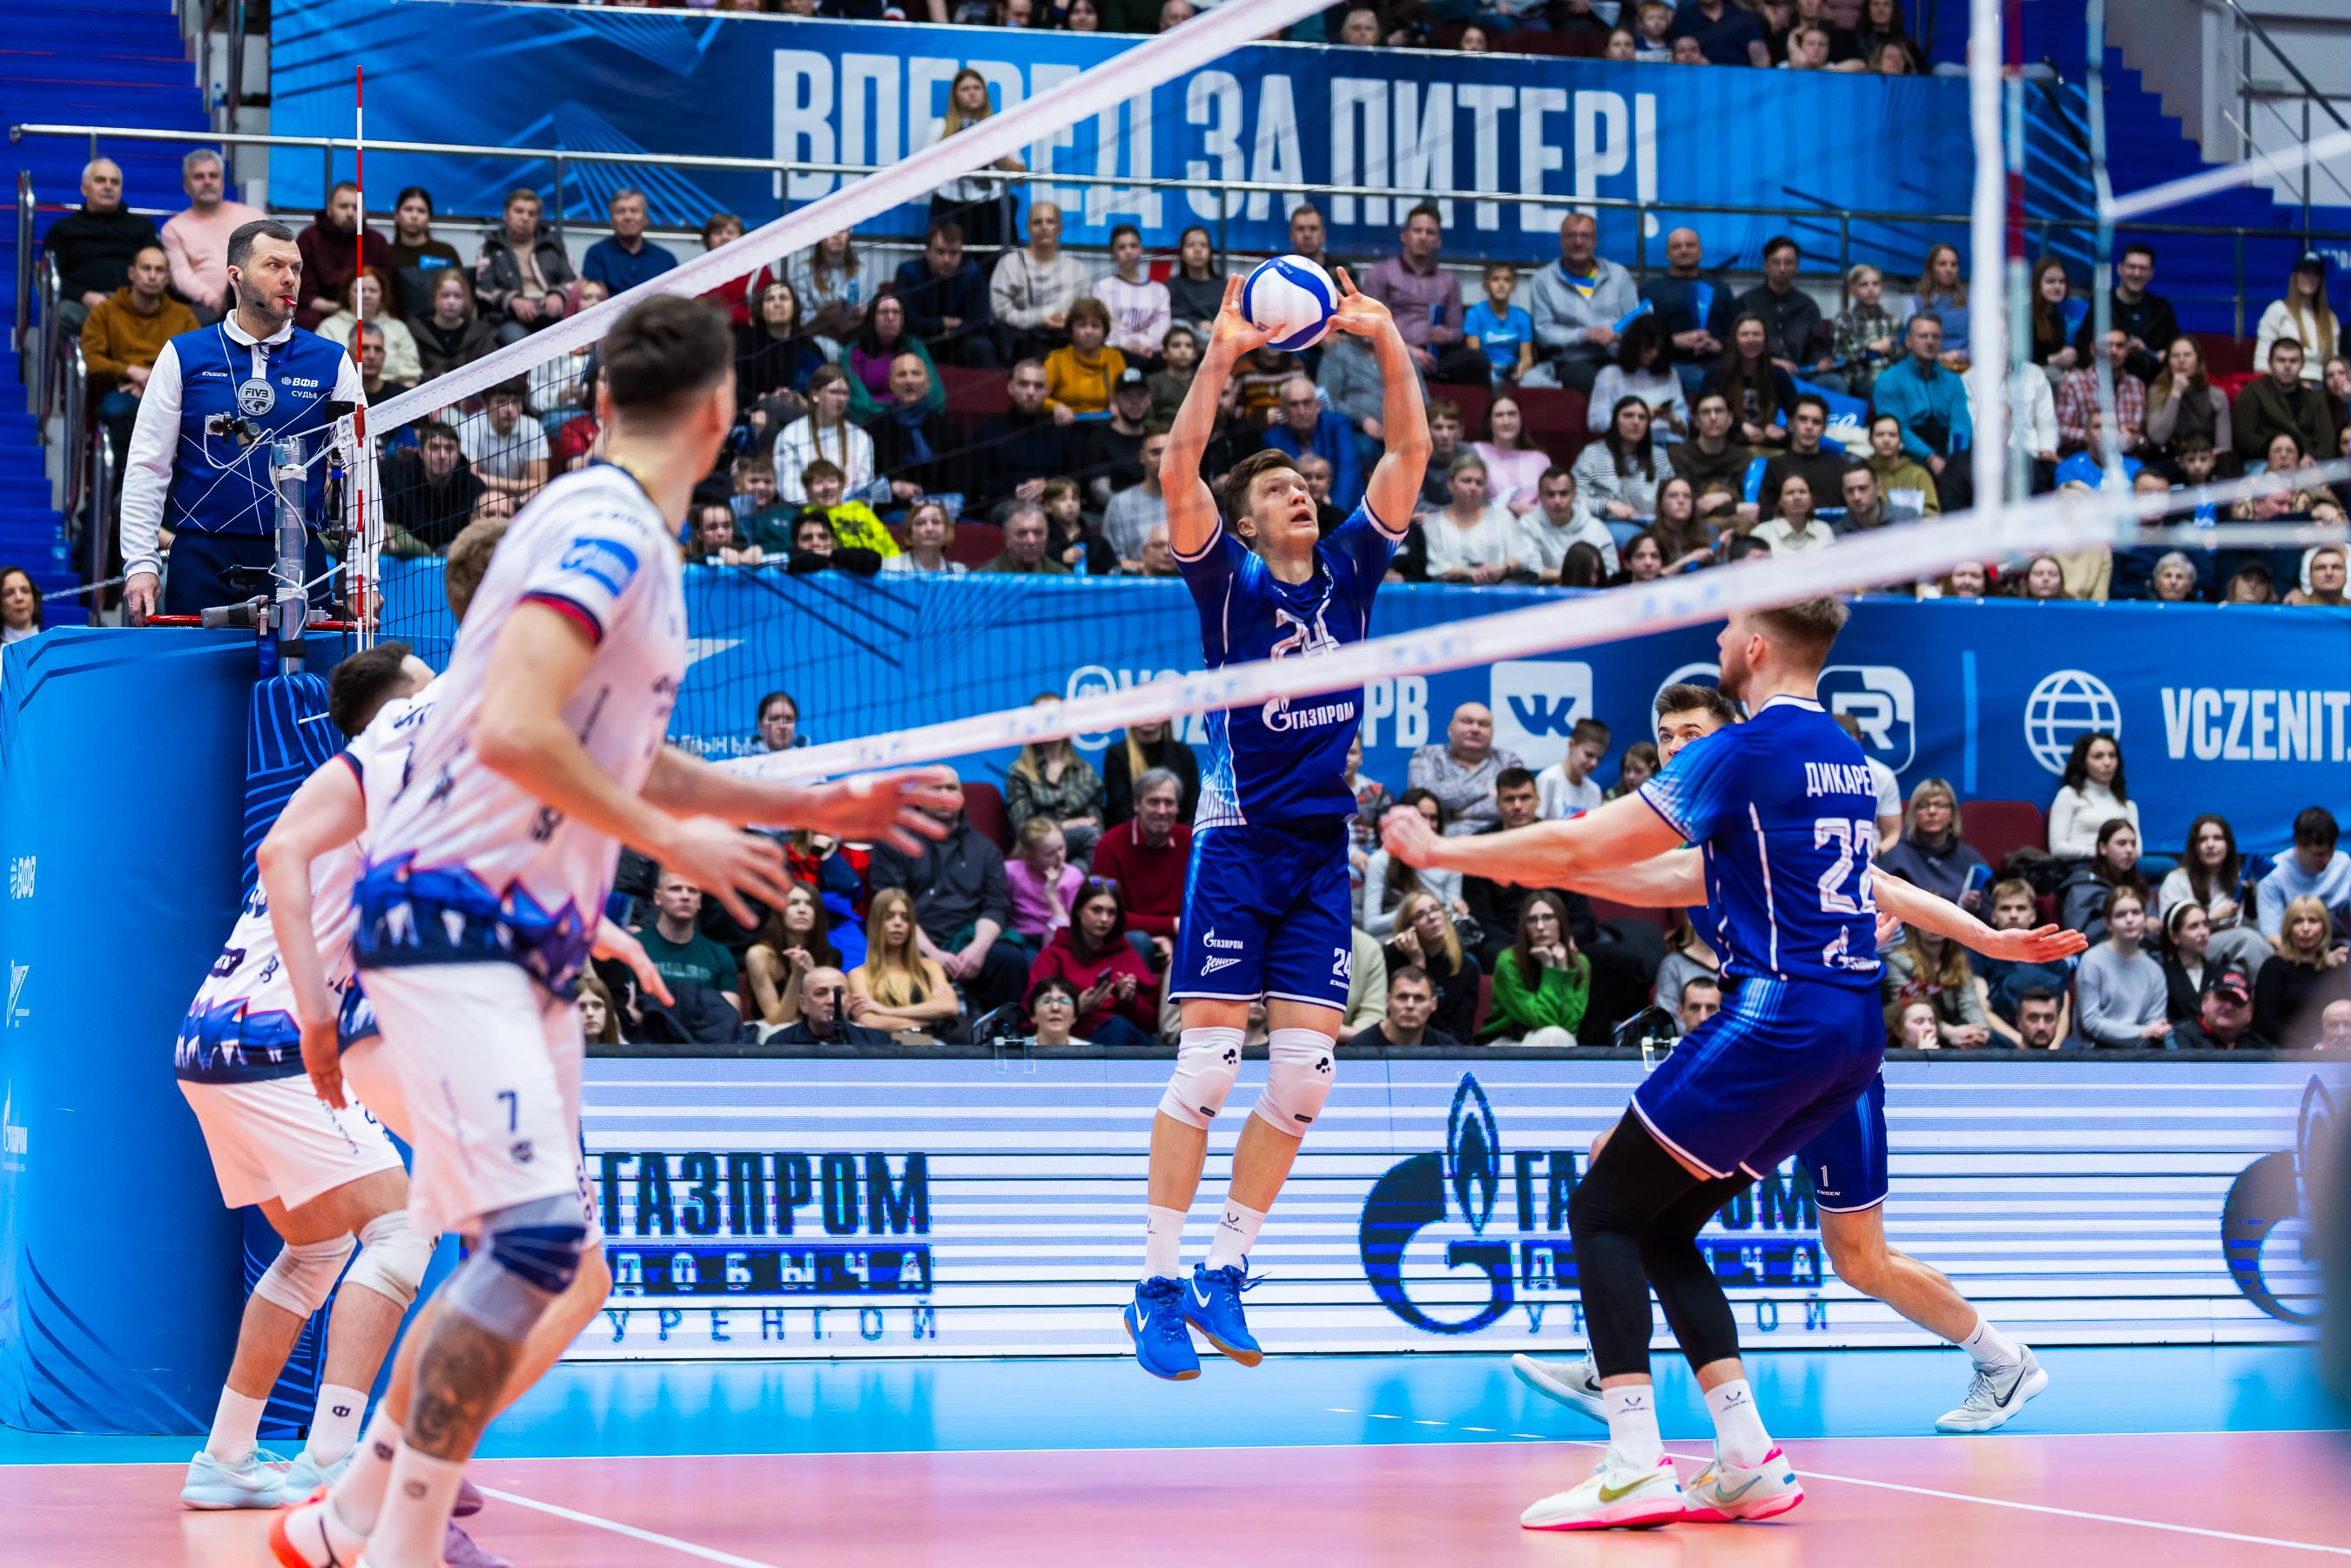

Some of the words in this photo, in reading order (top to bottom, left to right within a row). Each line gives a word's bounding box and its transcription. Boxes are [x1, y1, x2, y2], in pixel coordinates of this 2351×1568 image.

[1186, 70, 1304, 222] ЗА
[1330, 77, 1661, 238] ПИТЕР!
[246, 387, 269, 398] FIVB
[291, 390, 318, 400] СУДЬЯ
[1290, 702, 1355, 730] ГАЗПРОМ
[1332, 947, 1351, 979] 24
[497, 1089, 517, 1134] 7
[602, 1152, 930, 1236] ГАЗПРОМ
[1820, 1165, 1829, 1188] 1
[613, 1251, 924, 1295] ДОБЫЧА
[607, 1299, 939, 1343] УРЕНГОЙ
